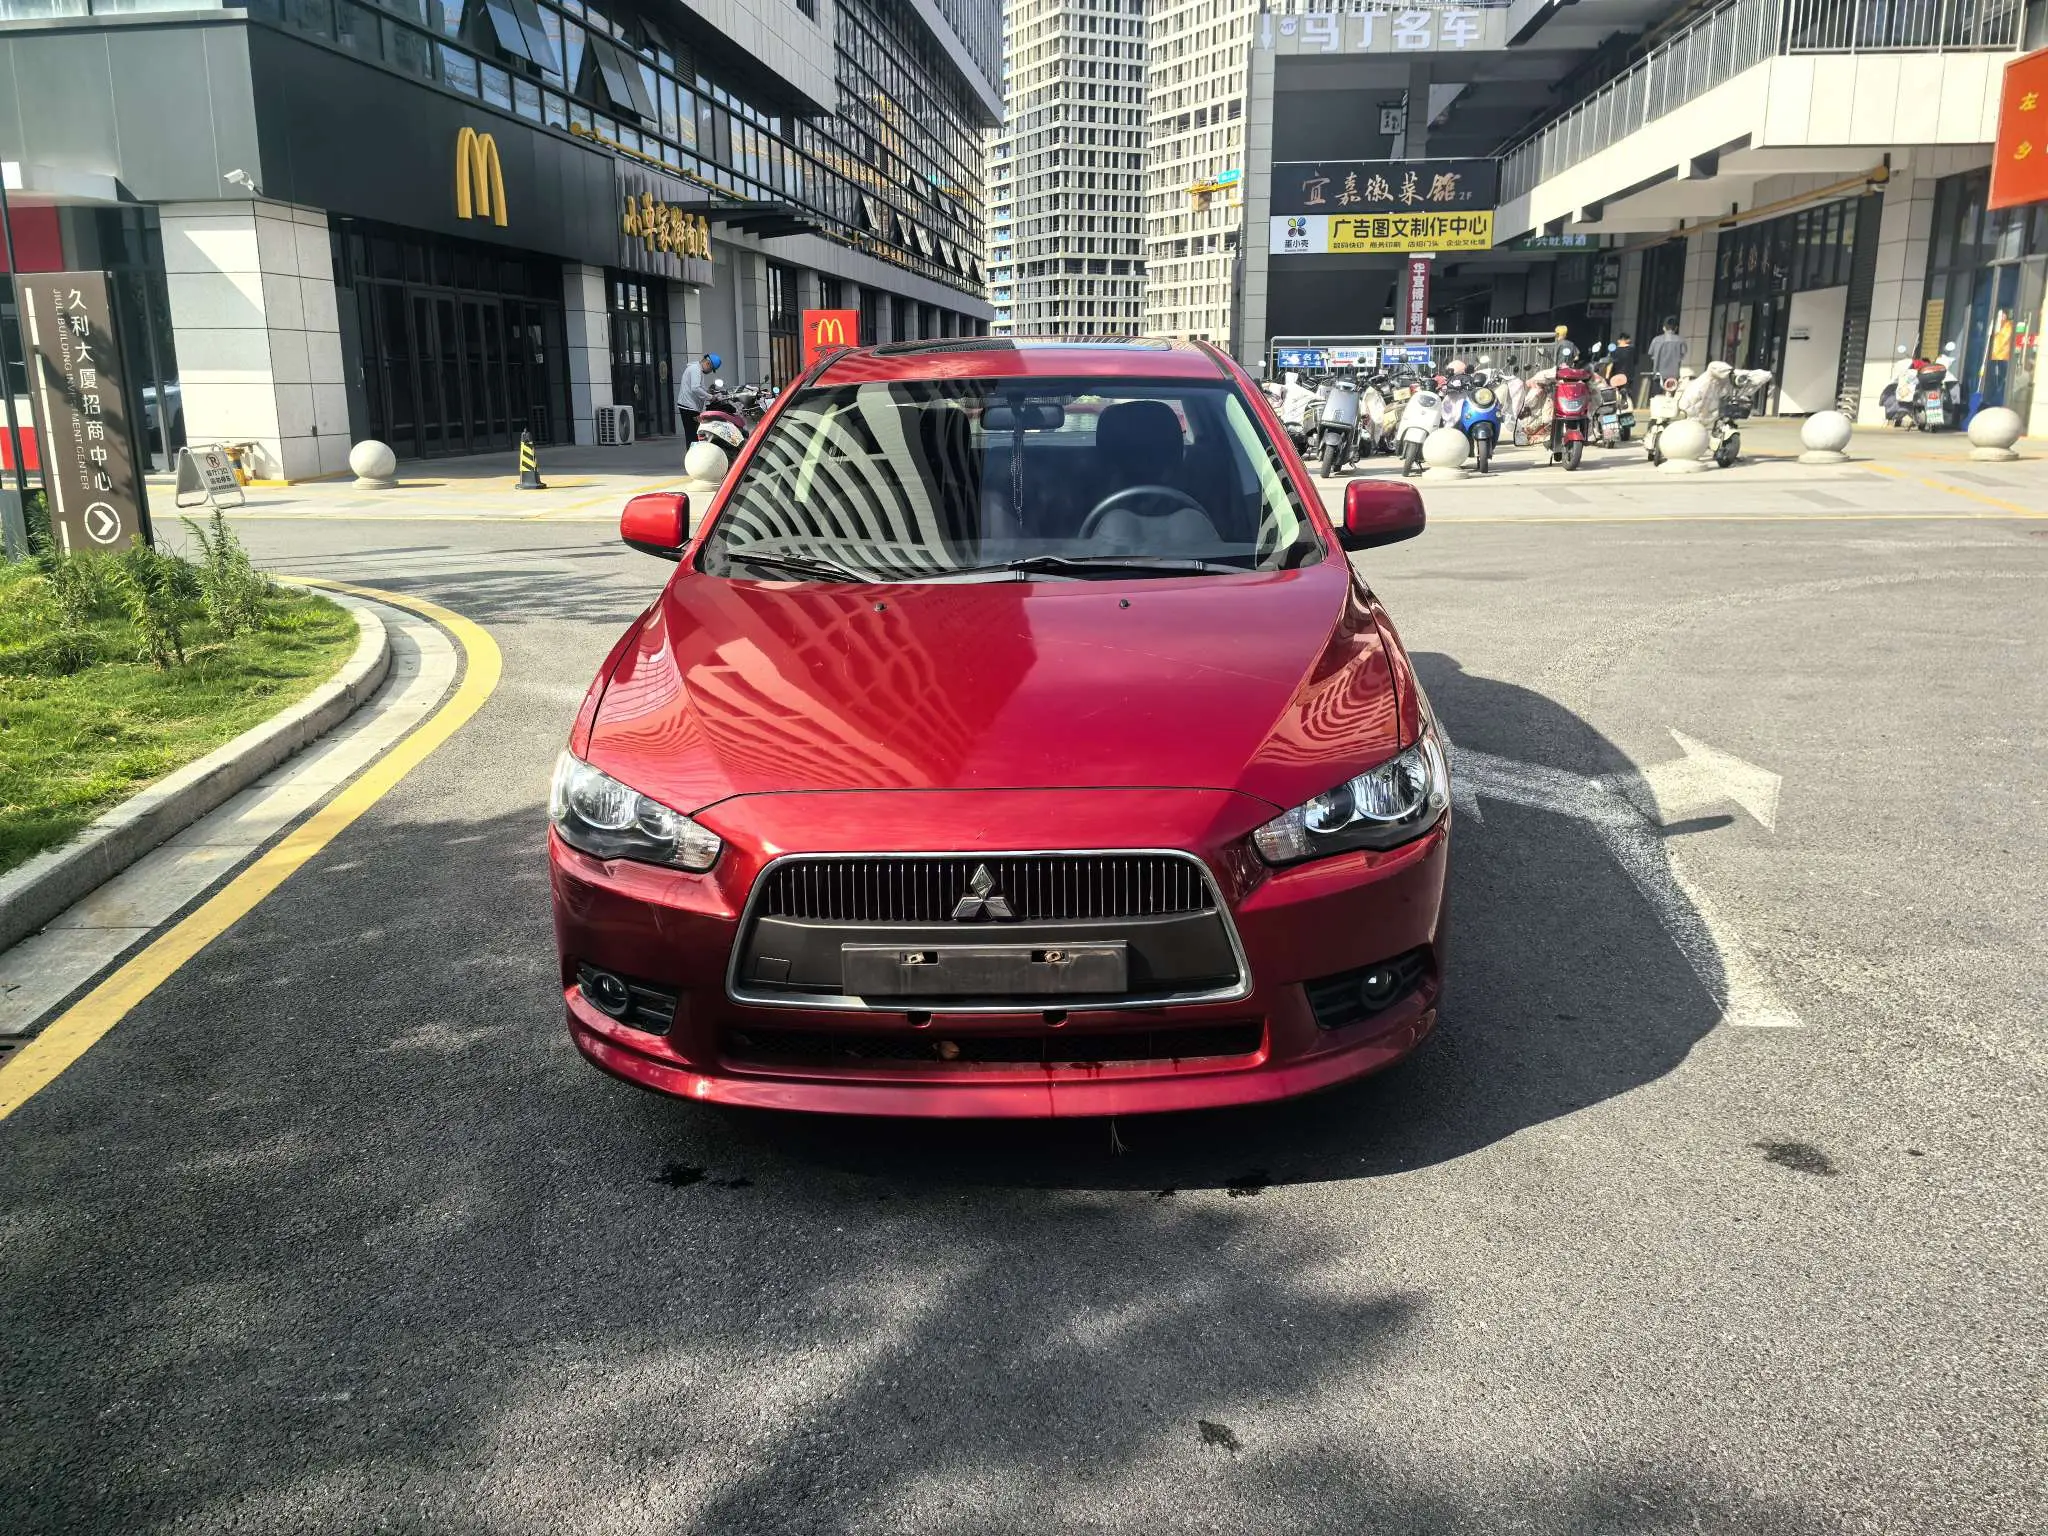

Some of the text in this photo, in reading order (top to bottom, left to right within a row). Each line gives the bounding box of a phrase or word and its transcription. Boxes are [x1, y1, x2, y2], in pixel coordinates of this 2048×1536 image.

[1301, 10, 1480, 51] 马丁名车
[1333, 216, 1487, 239] 广告图文制作中心
[68, 288, 113, 492] 久利大厦招商中心
[65, 374, 83, 445] INVTMENT
[76, 445, 90, 491] CENTER
